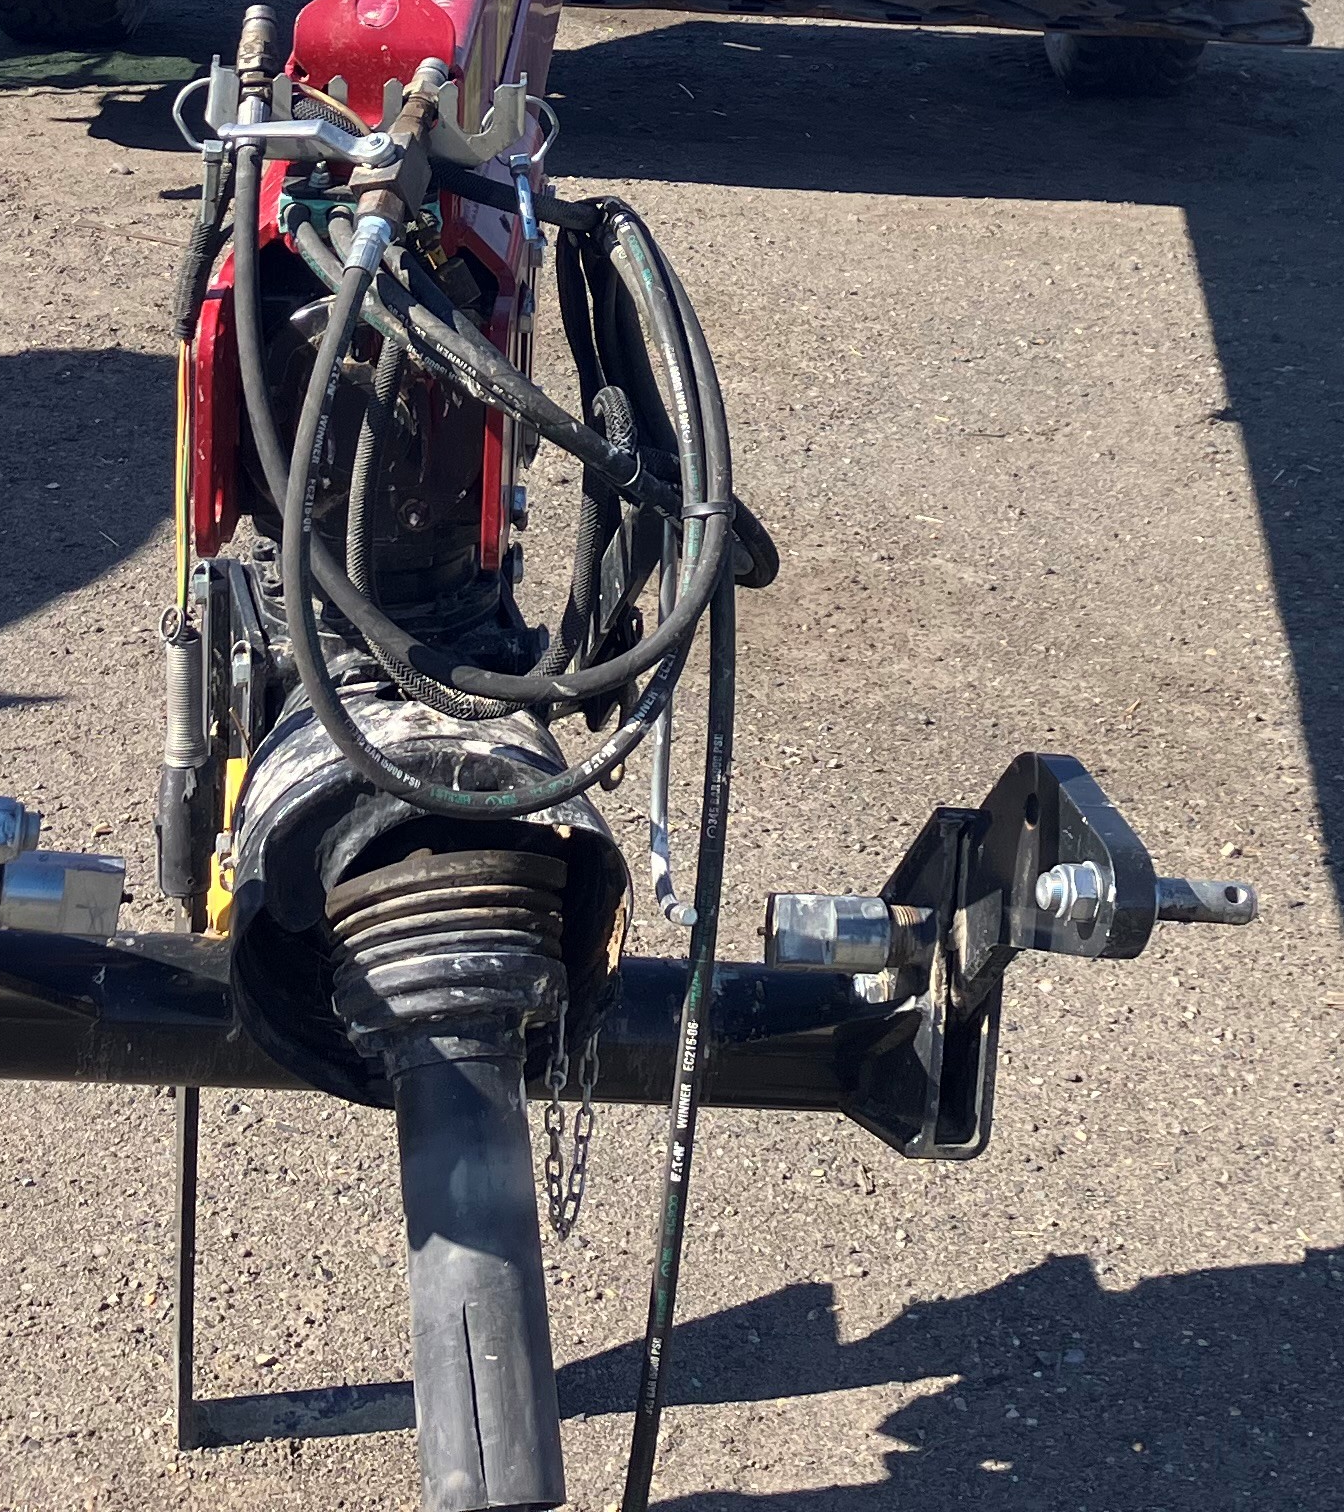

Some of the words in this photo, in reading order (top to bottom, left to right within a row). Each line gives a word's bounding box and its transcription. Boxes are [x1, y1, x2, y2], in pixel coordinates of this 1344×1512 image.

[435, 343, 478, 378] WINNER
[312, 414, 329, 464] WINNER
[676, 1083, 692, 1129] WINNER
